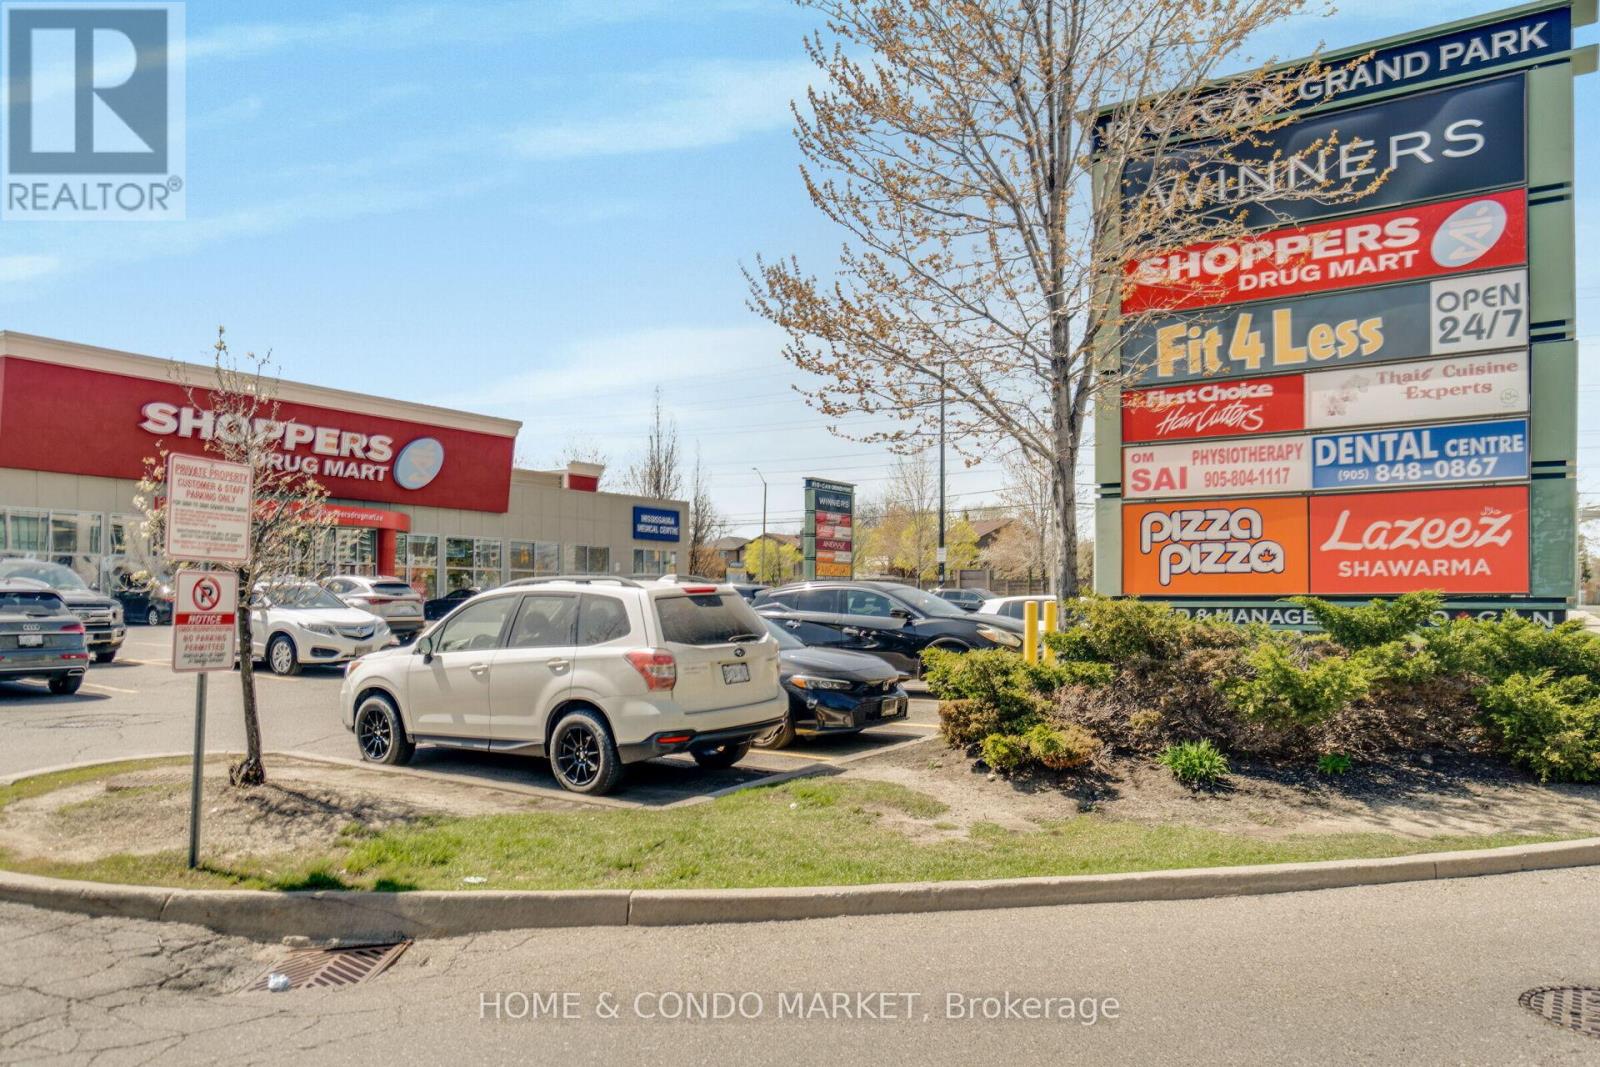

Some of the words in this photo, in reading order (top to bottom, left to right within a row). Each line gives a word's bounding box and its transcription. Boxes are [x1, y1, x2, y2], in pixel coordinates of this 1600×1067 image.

[1299, 51, 1431, 100] GRAND
[1439, 21, 1549, 71] PARK
[1152, 118, 1485, 208] WINNERS
[1136, 216, 1421, 285] SHOPPERS
[1238, 264, 1321, 292] DRUG
[1327, 249, 1420, 280] MART
[1436, 282, 1521, 313] OPEN
[1438, 308, 1523, 345] 24/7
[1156, 321, 1223, 377] Fit
[1228, 312, 1265, 370] 4
[1272, 307, 1385, 366] Less
[1442, 360, 1519, 378] Cuisine
[1146, 387, 1197, 408] First
[1197, 382, 1274, 402] Choice
[1404, 381, 1493, 400] Experts
[140, 401, 394, 463] SHOPPERS
[1155, 405, 1198, 436] Hair
[1130, 452, 1154, 464] OM
[1191, 443, 1304, 466] PHYSIOTHERAPY
[1315, 430, 1439, 467] DENTAL
[1444, 434, 1524, 457] CENTRE
[175, 464, 208, 478] PRIVATE
[209, 469, 248, 482] PROPERTY
[323, 458, 391, 482] MART
[1130, 466, 1188, 492] SAI
[1203, 467, 1290, 488] 905-804-1117
[1337, 468, 1369, 482] (905)
[1375, 457, 1499, 482] 848-0867
[177, 479, 216, 490] CUSTOMER
[186, 490, 216, 501] PARKING
[818, 496, 849, 509] WINNERS
[1319, 509, 1513, 552] Lazeez
[1338, 558, 1492, 577] SHAWARMA
[188, 614, 223, 625] NOTICE
[1215, 608, 1322, 625] MANAGE
[183, 634, 194, 642] NO
[195, 633, 227, 642] PARKING
